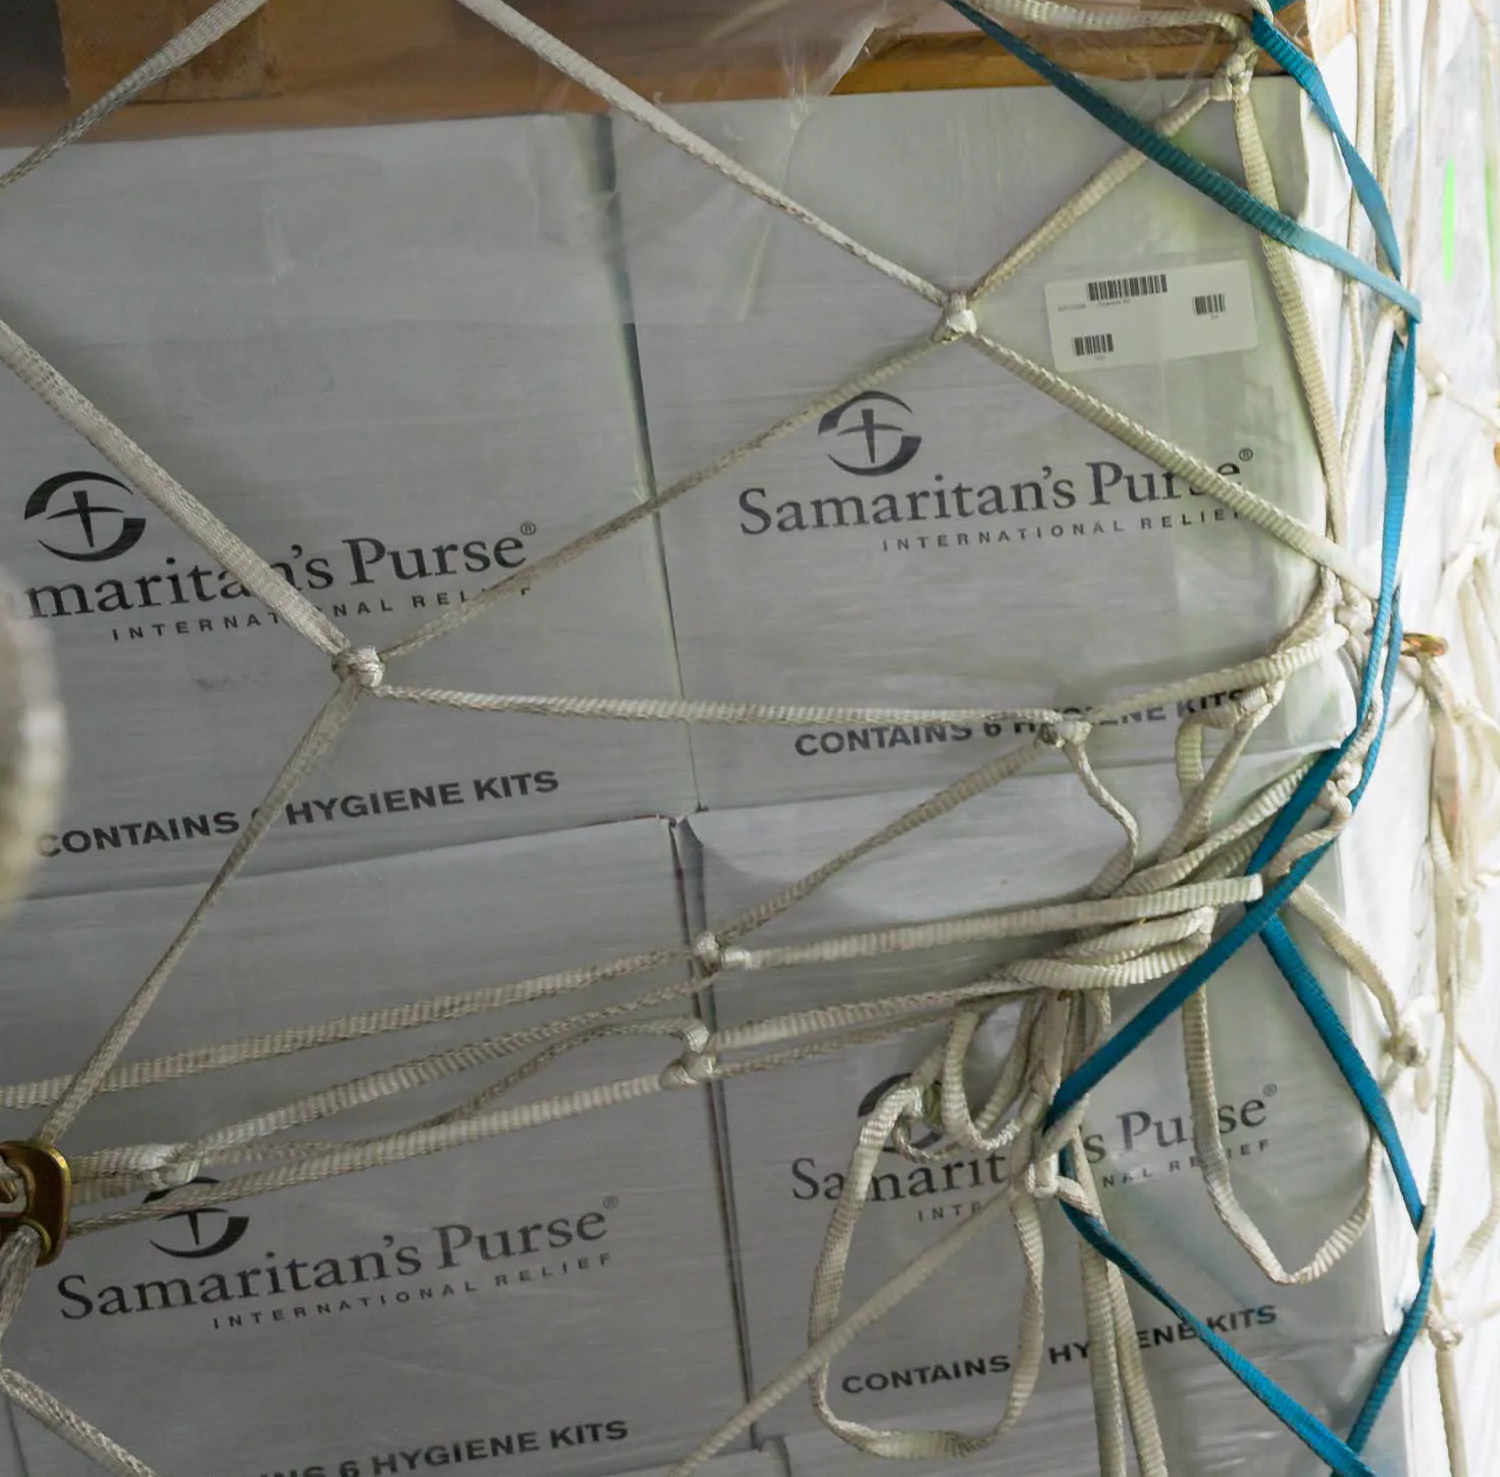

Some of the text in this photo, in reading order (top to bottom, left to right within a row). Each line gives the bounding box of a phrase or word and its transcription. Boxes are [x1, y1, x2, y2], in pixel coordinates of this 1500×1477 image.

[738, 465, 1077, 536] Samaritan's
[881, 519, 1125, 552] INTERNATIONAL
[37, 769, 560, 858] CONTAINS HYGIENE KITS
[57, 1234, 423, 1321] Samaritan's
[212, 1252, 613, 1330] INTERNATIONAL RELIEF
[841, 1353, 1012, 1396] CONTAINS
[1207, 1304, 1278, 1334] KITS
[372, 1431, 541, 1477] HYGIENE
[550, 1418, 630, 1455] KITS
